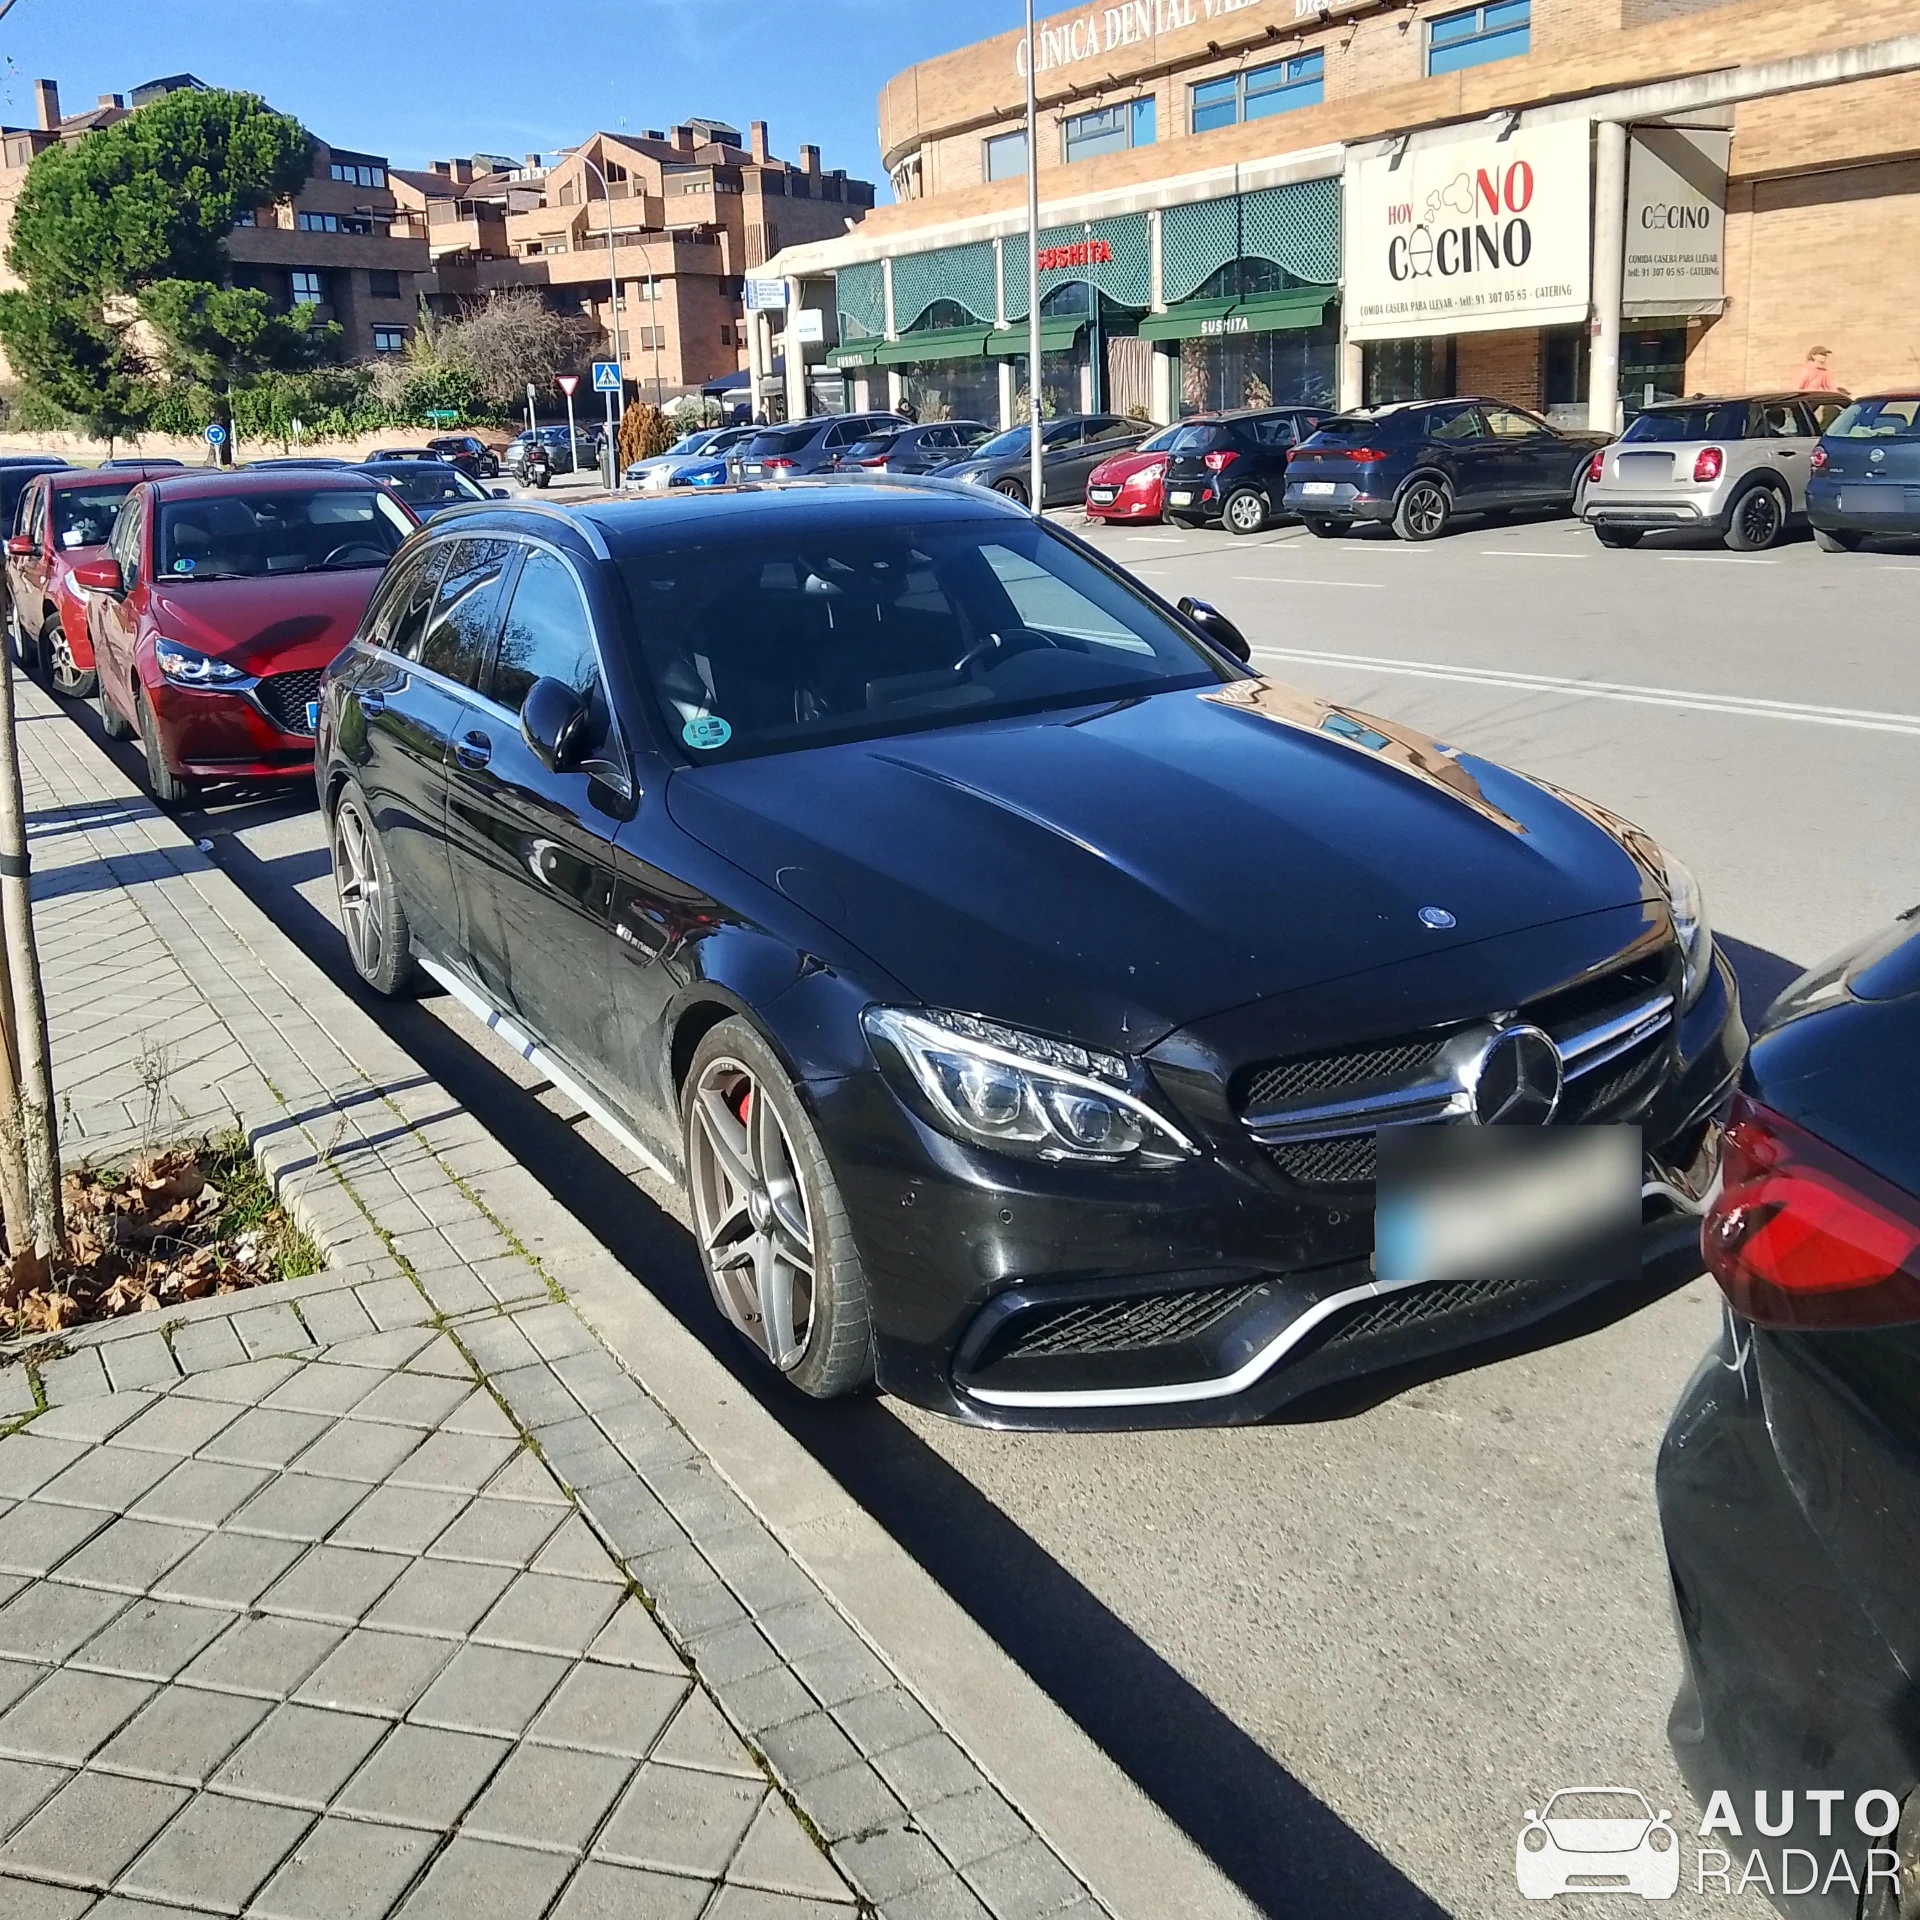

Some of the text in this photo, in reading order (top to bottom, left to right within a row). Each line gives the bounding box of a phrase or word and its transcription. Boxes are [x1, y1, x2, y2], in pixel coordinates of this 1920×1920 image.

[1016, 0, 1197, 78] CÍNICA DENTAL
[1388, 160, 1534, 225] HOY NO
[1689, 267, 1719, 276] CATERING
[1360, 304, 1384, 316] COMIDA
[1385, 302, 1409, 313] CASERA
[1410, 300, 1427, 312] PARA
[1429, 298, 1453, 310] LLEVAR
[1535, 284, 1572, 299] CATERING
[1201, 317, 1249, 334] SUSHITA
[836, 354, 863, 368] SUSHITA
